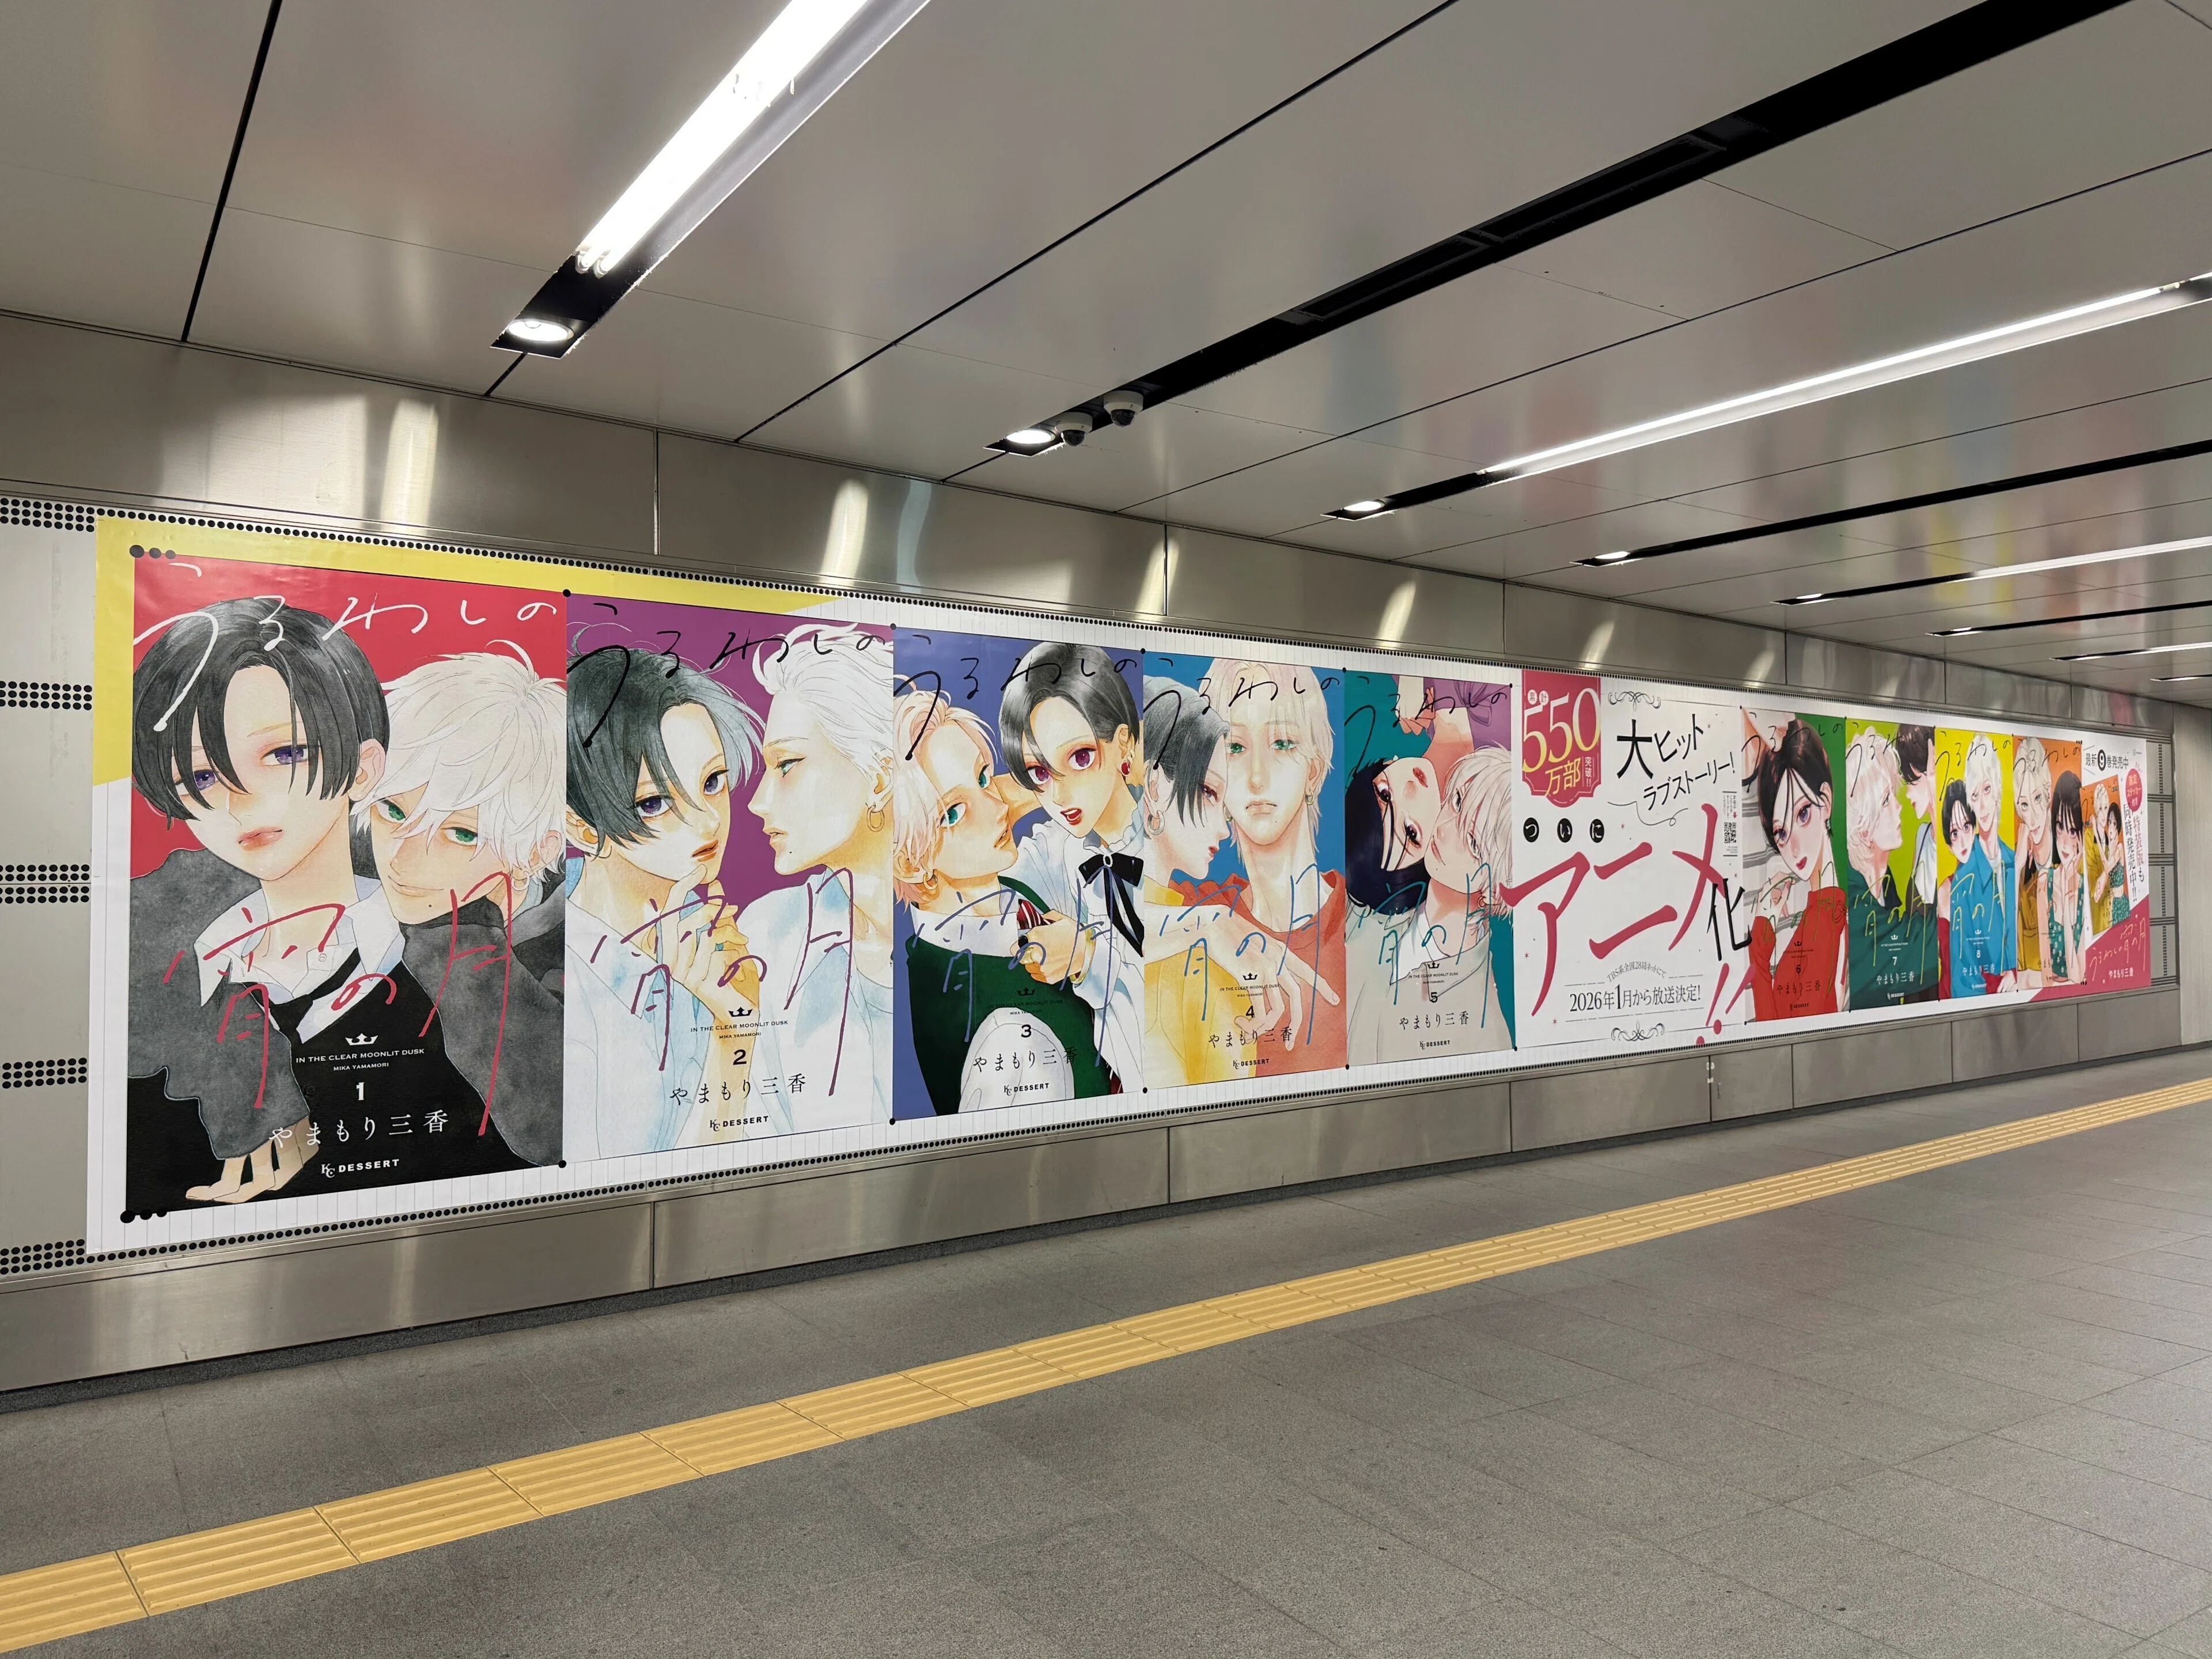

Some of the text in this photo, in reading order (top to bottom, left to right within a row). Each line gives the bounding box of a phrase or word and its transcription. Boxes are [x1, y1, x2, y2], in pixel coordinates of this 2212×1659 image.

[134, 562, 557, 732] うるわしの
[566, 603, 885, 748] うるわしの
[893, 635, 1137, 760] うるわしの
[1143, 658, 1340, 770] うるわしの
[1522, 688, 1601, 773] 550
[1616, 714, 1704, 779] 大ヒット
[1545, 757, 1581, 797] 万部
[1643, 751, 1736, 811] ラブストーリー!
[1524, 821, 1603, 841] ついに
[1159, 863, 1320, 1046] 宵の月
[1358, 863, 1491, 1028] 宵の月
[1976, 949, 1981, 958] 8
[912, 865, 1112, 1067] 宵の月
[1796, 964, 1801, 974] 6
[1892, 956, 1897, 965] 7
[591, 868, 853, 1096] 宵の月
[162, 872, 512, 1137] 宵の月
[1430, 992, 1438, 1003] 5
[1570, 984, 1700, 1012] 2026年1月から放送決定!
[1245, 1005, 1255, 1018] 4
[1399, 1011, 1468, 1030] やまもり三香
[1021, 1024, 1032, 1037] 3
[1209, 1026, 1292, 1048] やまもり三香
[360, 1051, 399, 1059] MOONLIT
[733, 1049, 747, 1066] 2
[974, 1046, 1077, 1073] やまもり三香
[356, 1082, 365, 1101] 1
[670, 1073, 806, 1105] やまもり三香
[1014, 1083, 1049, 1092] DESSERT
[268, 1109, 449, 1148] やまもり三香
[723, 1116, 769, 1127] DESSERT
[338, 1159, 400, 1173] DESSERT
